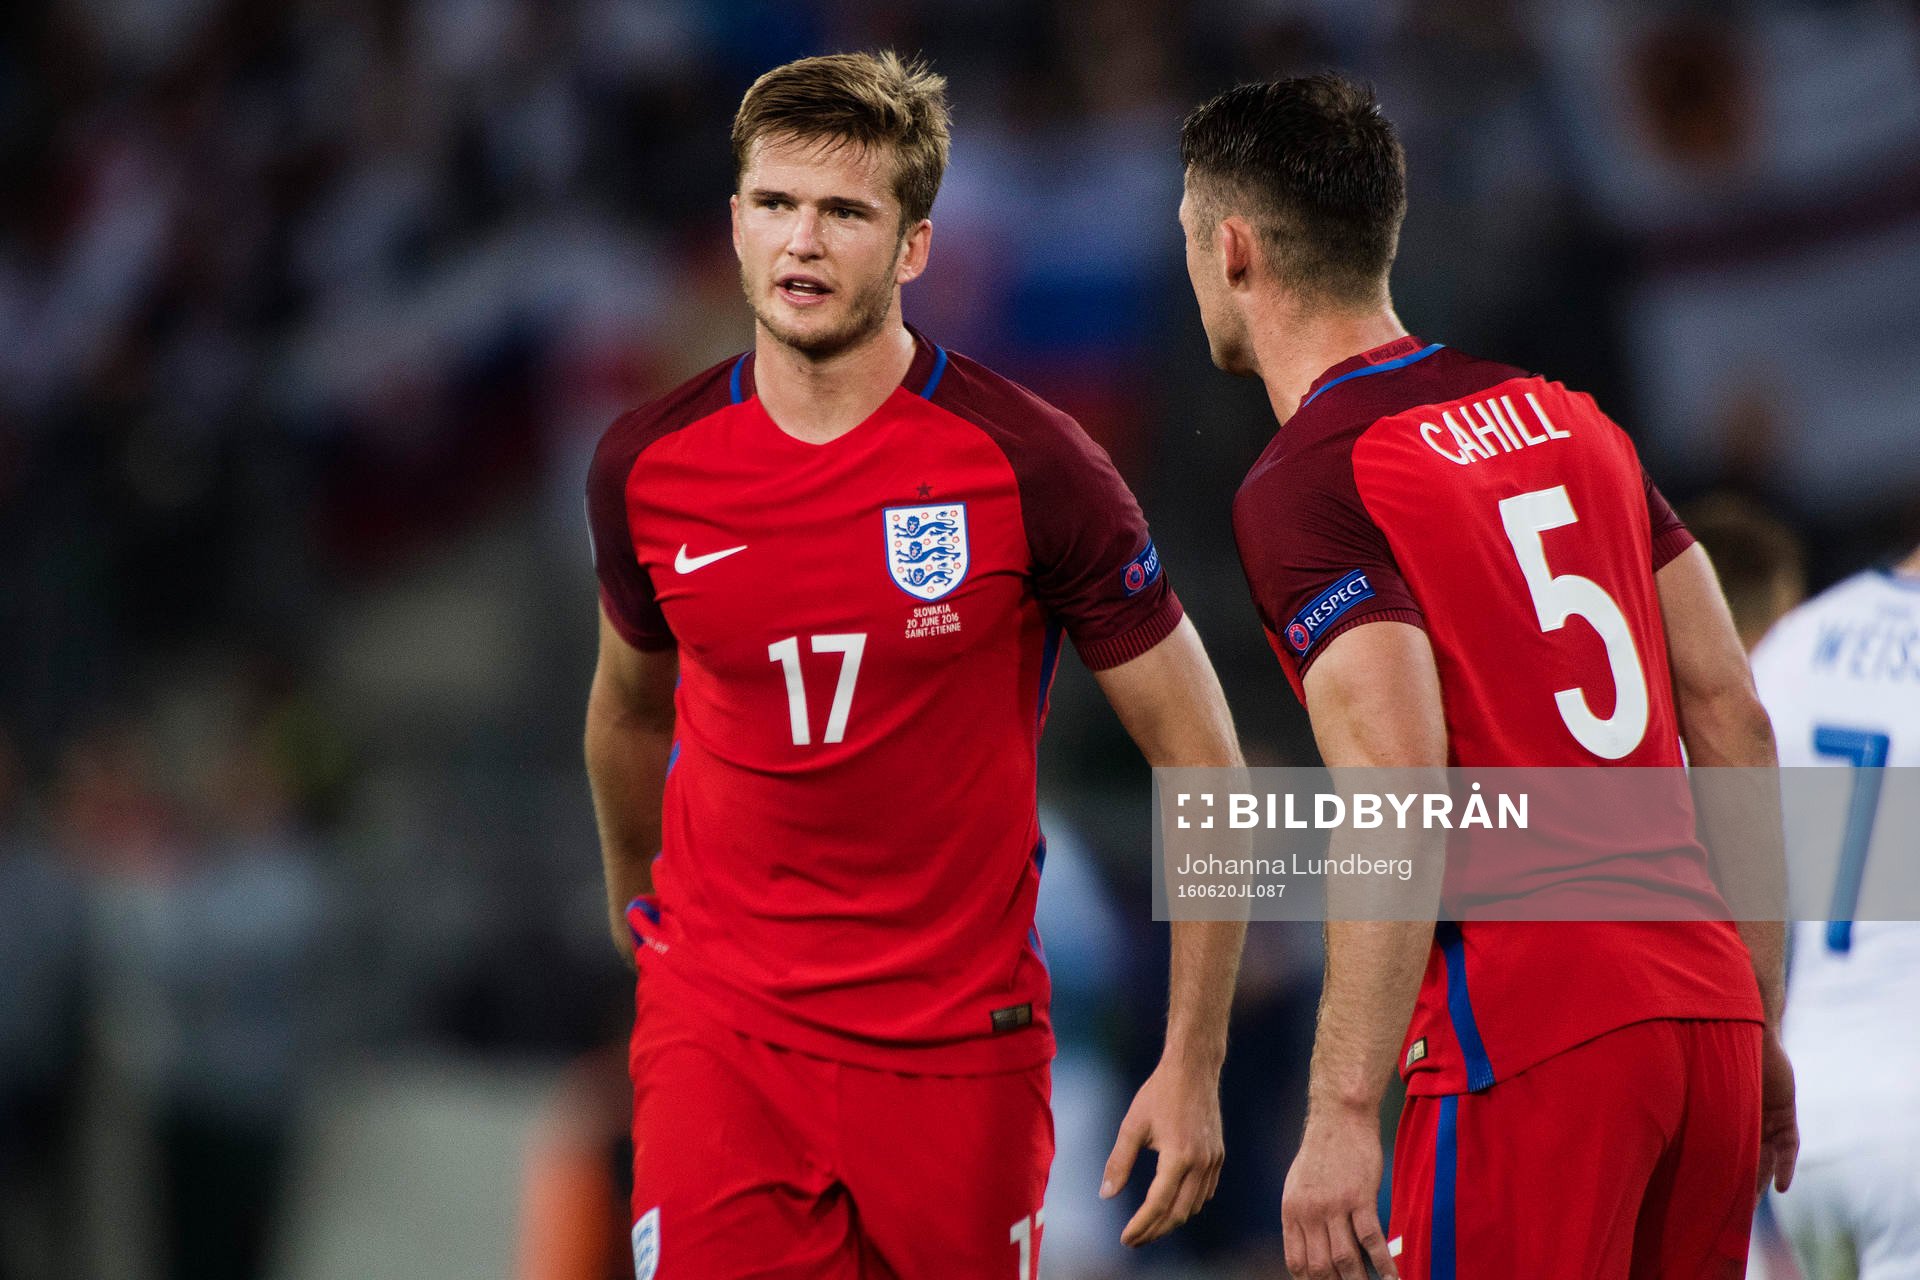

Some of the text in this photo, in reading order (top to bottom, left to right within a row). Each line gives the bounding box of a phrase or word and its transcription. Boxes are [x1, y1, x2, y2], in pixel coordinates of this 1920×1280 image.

[1420, 392, 1571, 465] CAHILL
[905, 622, 961, 639] SAINT-ETIENNE
[906, 612, 959, 629] 20 JUNE 2016
[913, 603, 951, 618] SLOVAKIA
[1304, 575, 1369, 632] RESPECT
[1498, 484, 1649, 760] 5
[768, 632, 867, 746] 17
[1814, 722, 1891, 957] 7
